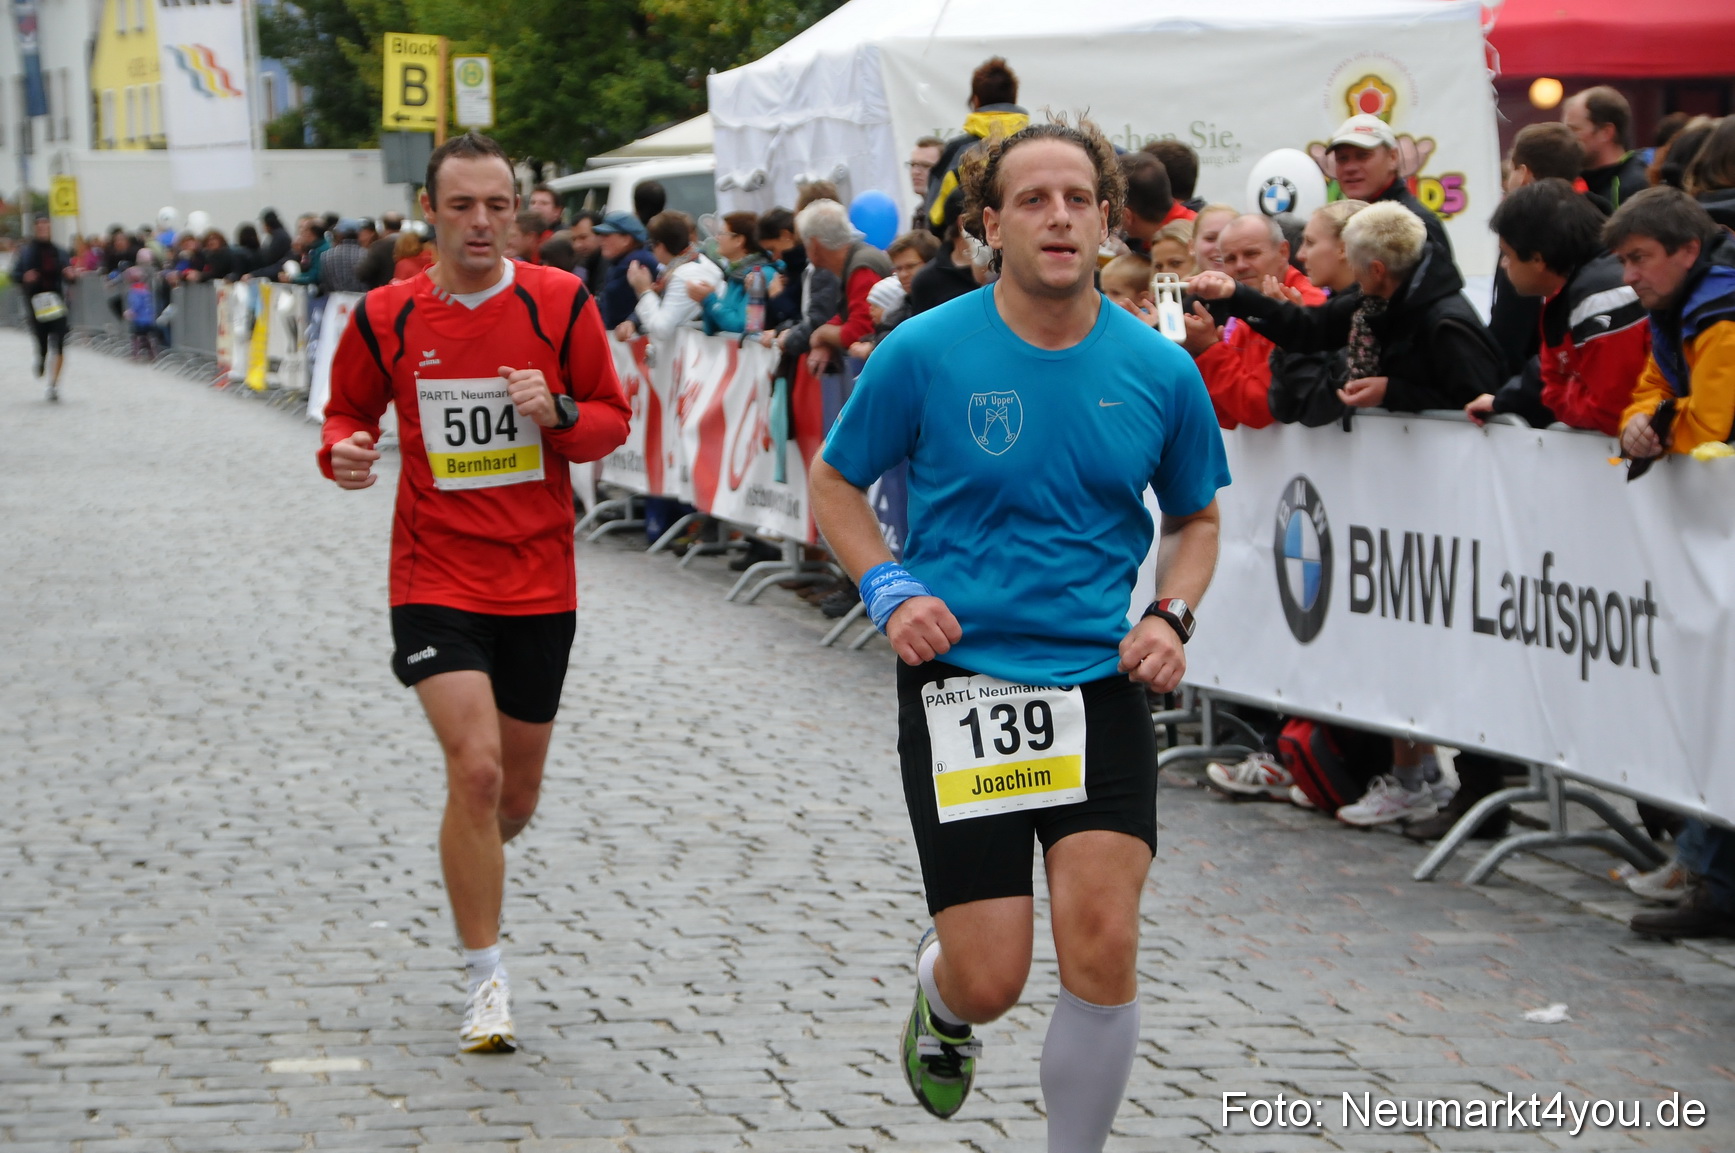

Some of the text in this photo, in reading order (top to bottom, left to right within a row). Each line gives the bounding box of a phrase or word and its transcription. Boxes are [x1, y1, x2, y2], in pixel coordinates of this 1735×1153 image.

[392, 37, 438, 55] Block
[403, 64, 428, 107] B
[1188, 120, 1242, 149] Sie.
[420, 388, 511, 401] PARTL Neumar
[974, 395, 1014, 408] TSV Upper
[443, 403, 518, 447] 504
[446, 453, 517, 474] Bernhard
[1349, 524, 1661, 682] BMW Laufsport
[925, 690, 976, 708] PARTL
[959, 699, 1055, 759] 139
[971, 767, 1052, 796] Joachim
